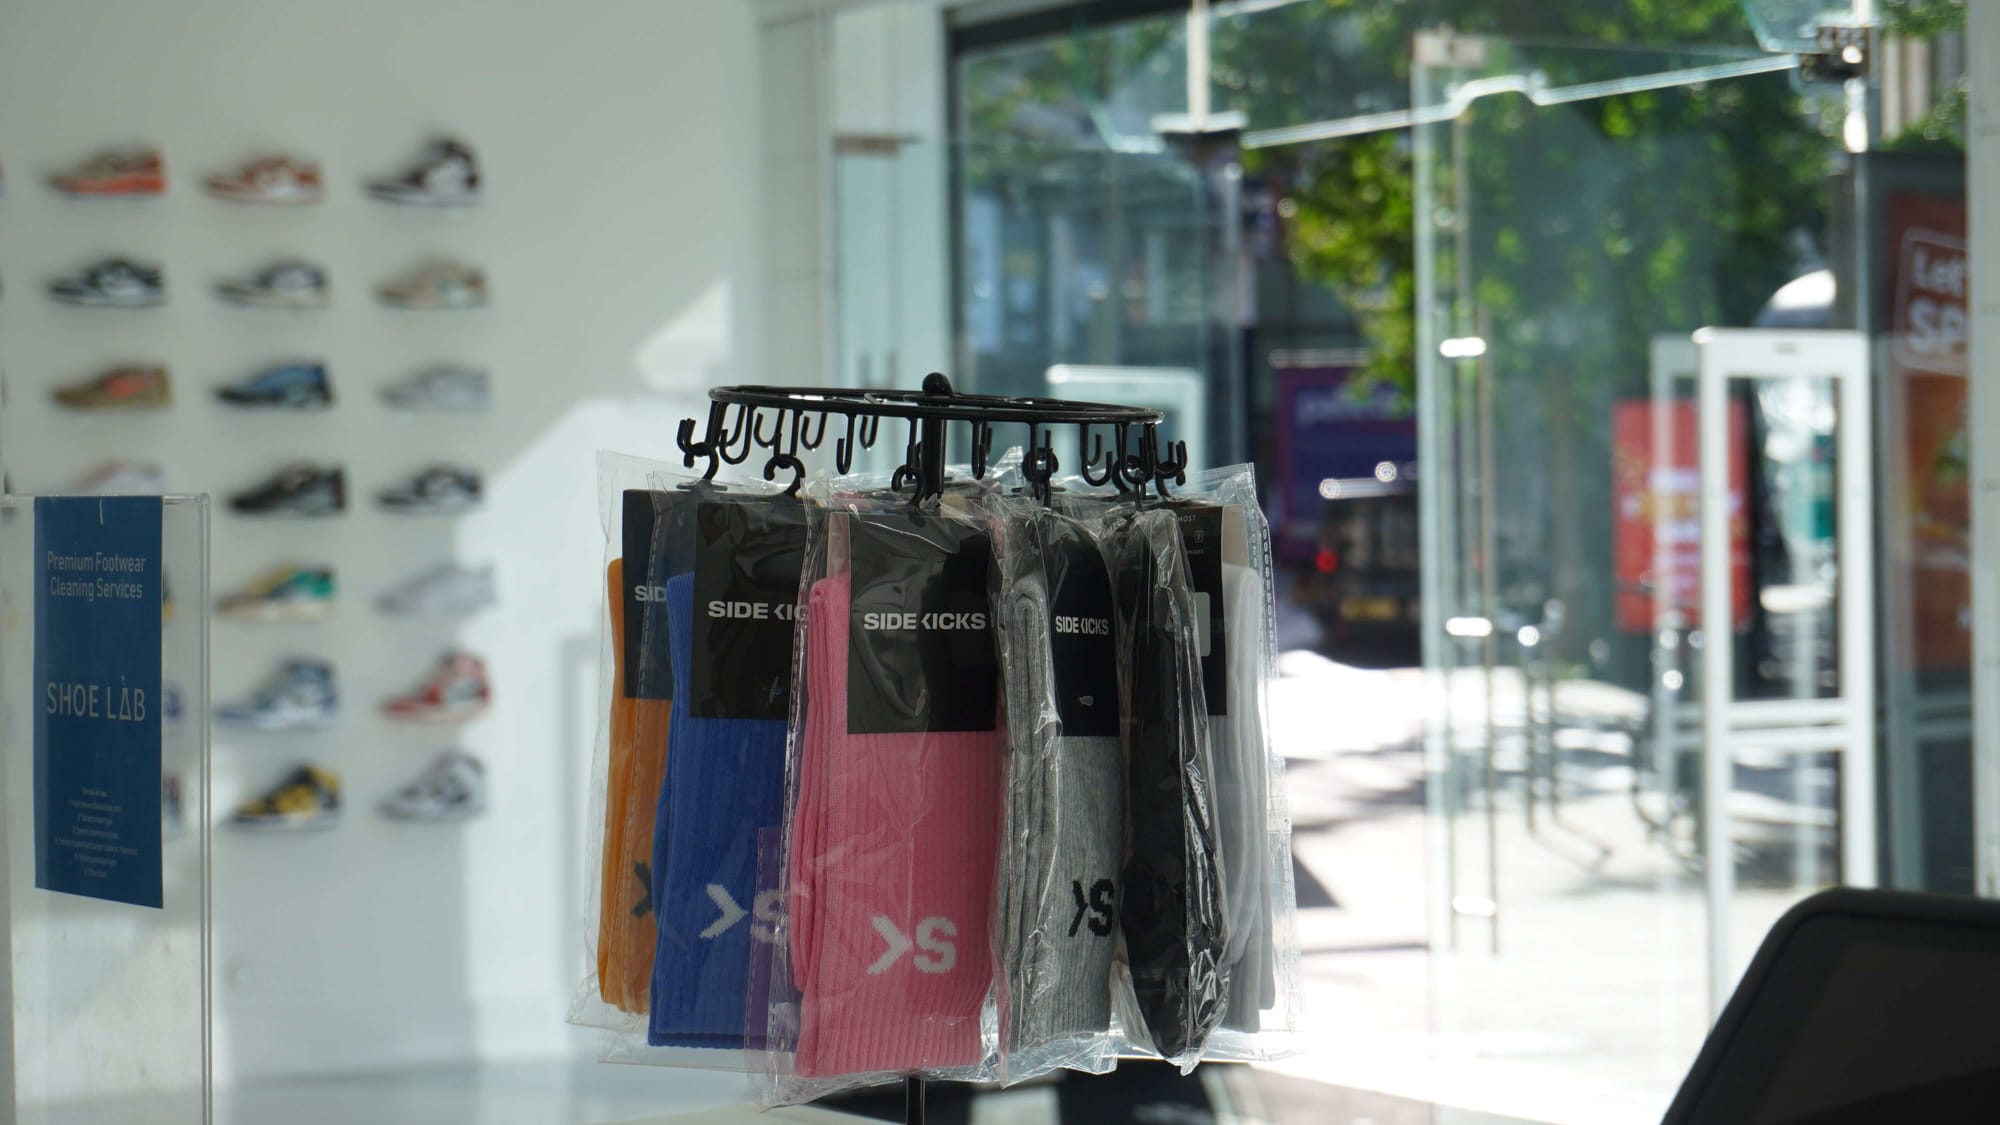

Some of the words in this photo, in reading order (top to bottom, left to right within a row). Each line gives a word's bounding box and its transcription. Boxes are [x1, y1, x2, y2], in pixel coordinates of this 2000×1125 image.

[47, 550, 94, 572] Premium
[95, 551, 147, 573] Footwear
[49, 576, 95, 602] Cleaning
[96, 577, 143, 599] Services
[47, 682, 100, 718] SHOE
[106, 674, 146, 722] LAB
